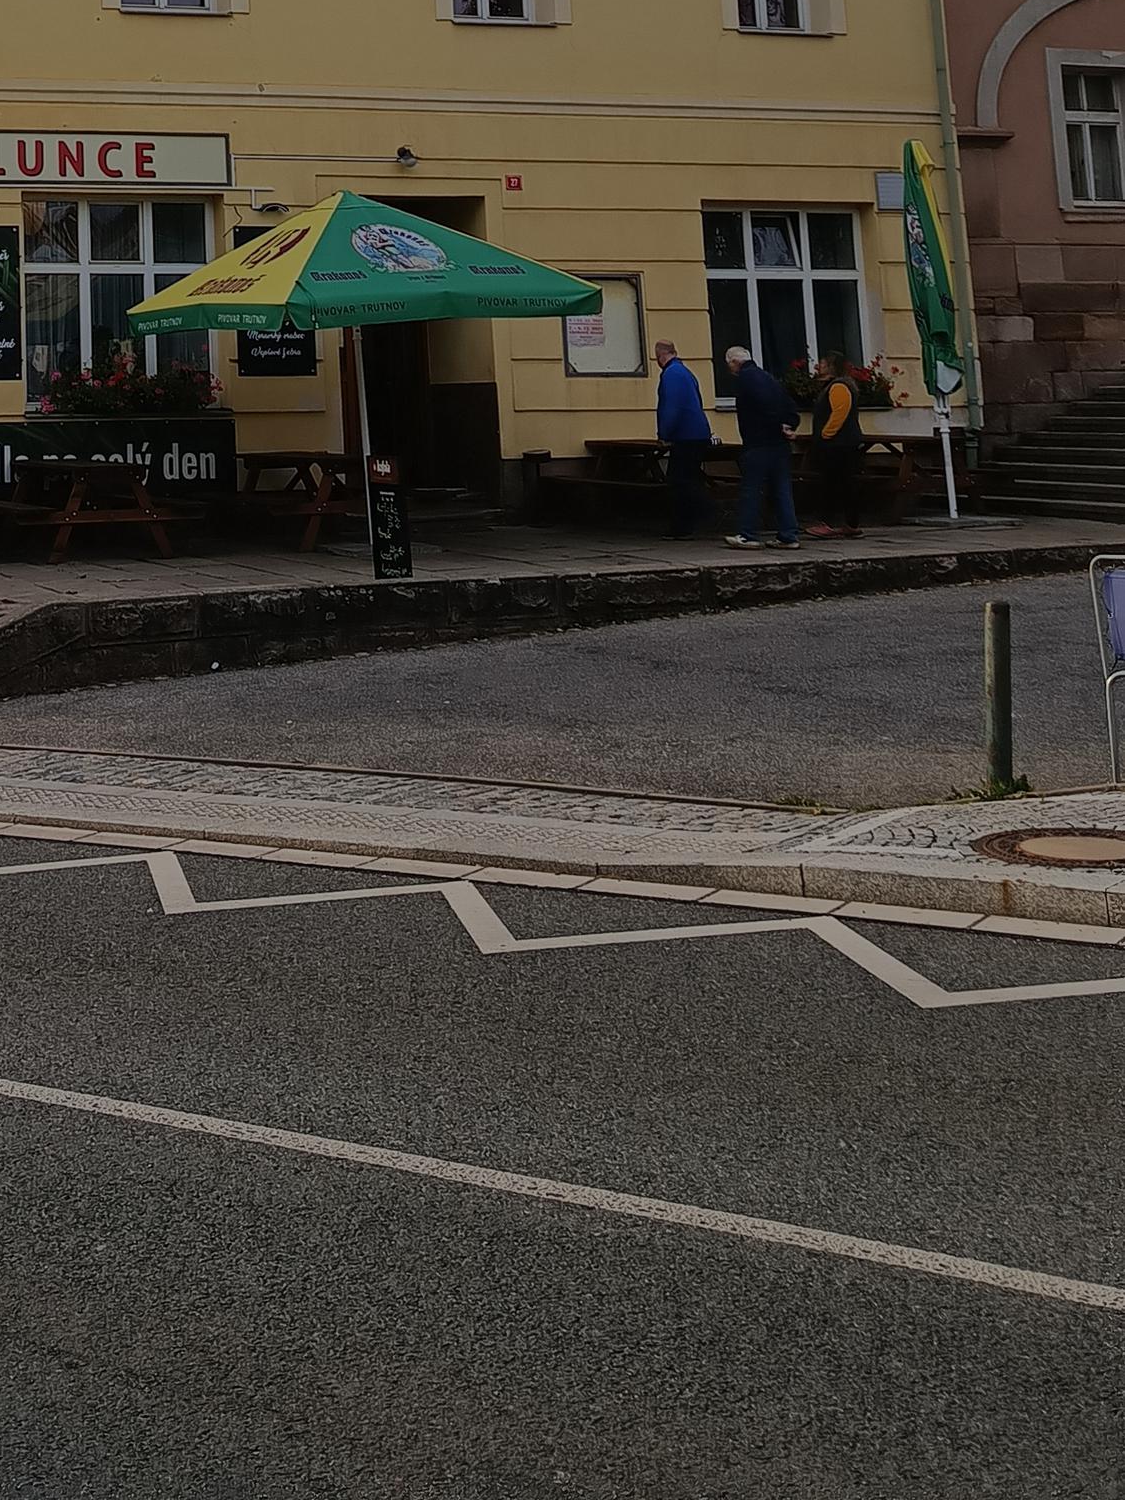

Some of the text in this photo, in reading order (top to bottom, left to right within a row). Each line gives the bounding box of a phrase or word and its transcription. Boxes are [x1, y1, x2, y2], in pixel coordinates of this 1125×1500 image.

[362, 301, 406, 314] TRUTNOV
[477, 296, 568, 308] PIVOVAR TRUTNOV
[217, 313, 267, 324] PIVOVAR TRUTNOV
[162, 442, 217, 481] den
